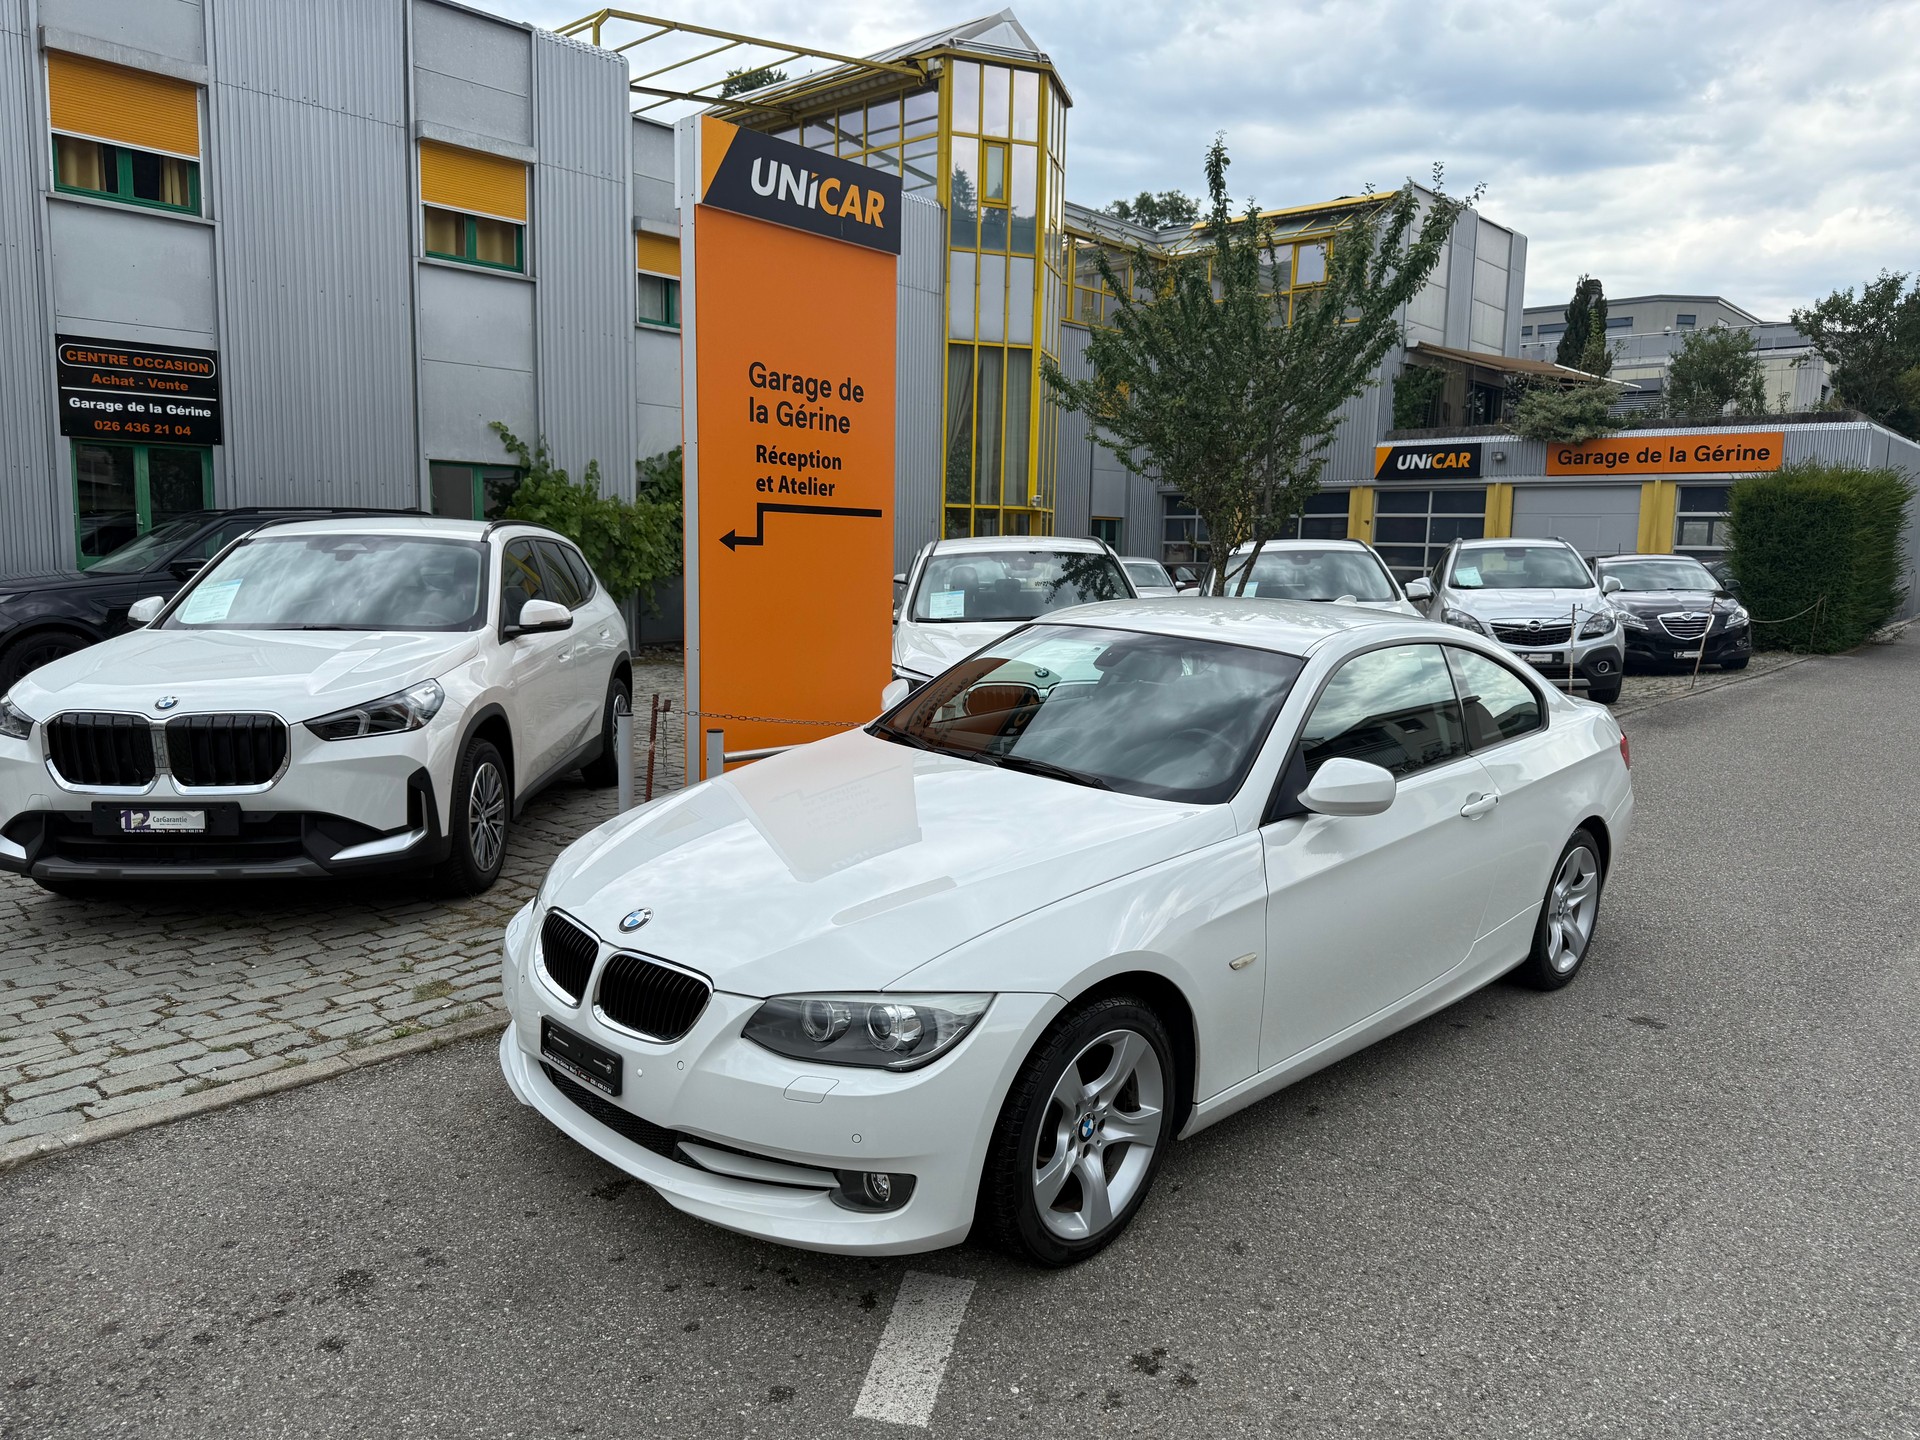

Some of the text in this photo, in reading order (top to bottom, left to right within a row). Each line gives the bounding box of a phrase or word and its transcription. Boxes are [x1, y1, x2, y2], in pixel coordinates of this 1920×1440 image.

[66, 350, 209, 373] CENTRE OCCASION
[91, 373, 135, 387] Achat
[148, 378, 189, 391] Vente
[748, 361, 865, 403] Garage de
[69, 397, 212, 417] Garage de la Gérine
[749, 396, 851, 434] la Gérine
[94, 420, 191, 436] 026 436 21 04
[756, 444, 842, 472] Réception
[1557, 443, 1770, 468] Garage de la Gérine
[756, 475, 836, 497] et Atelier
